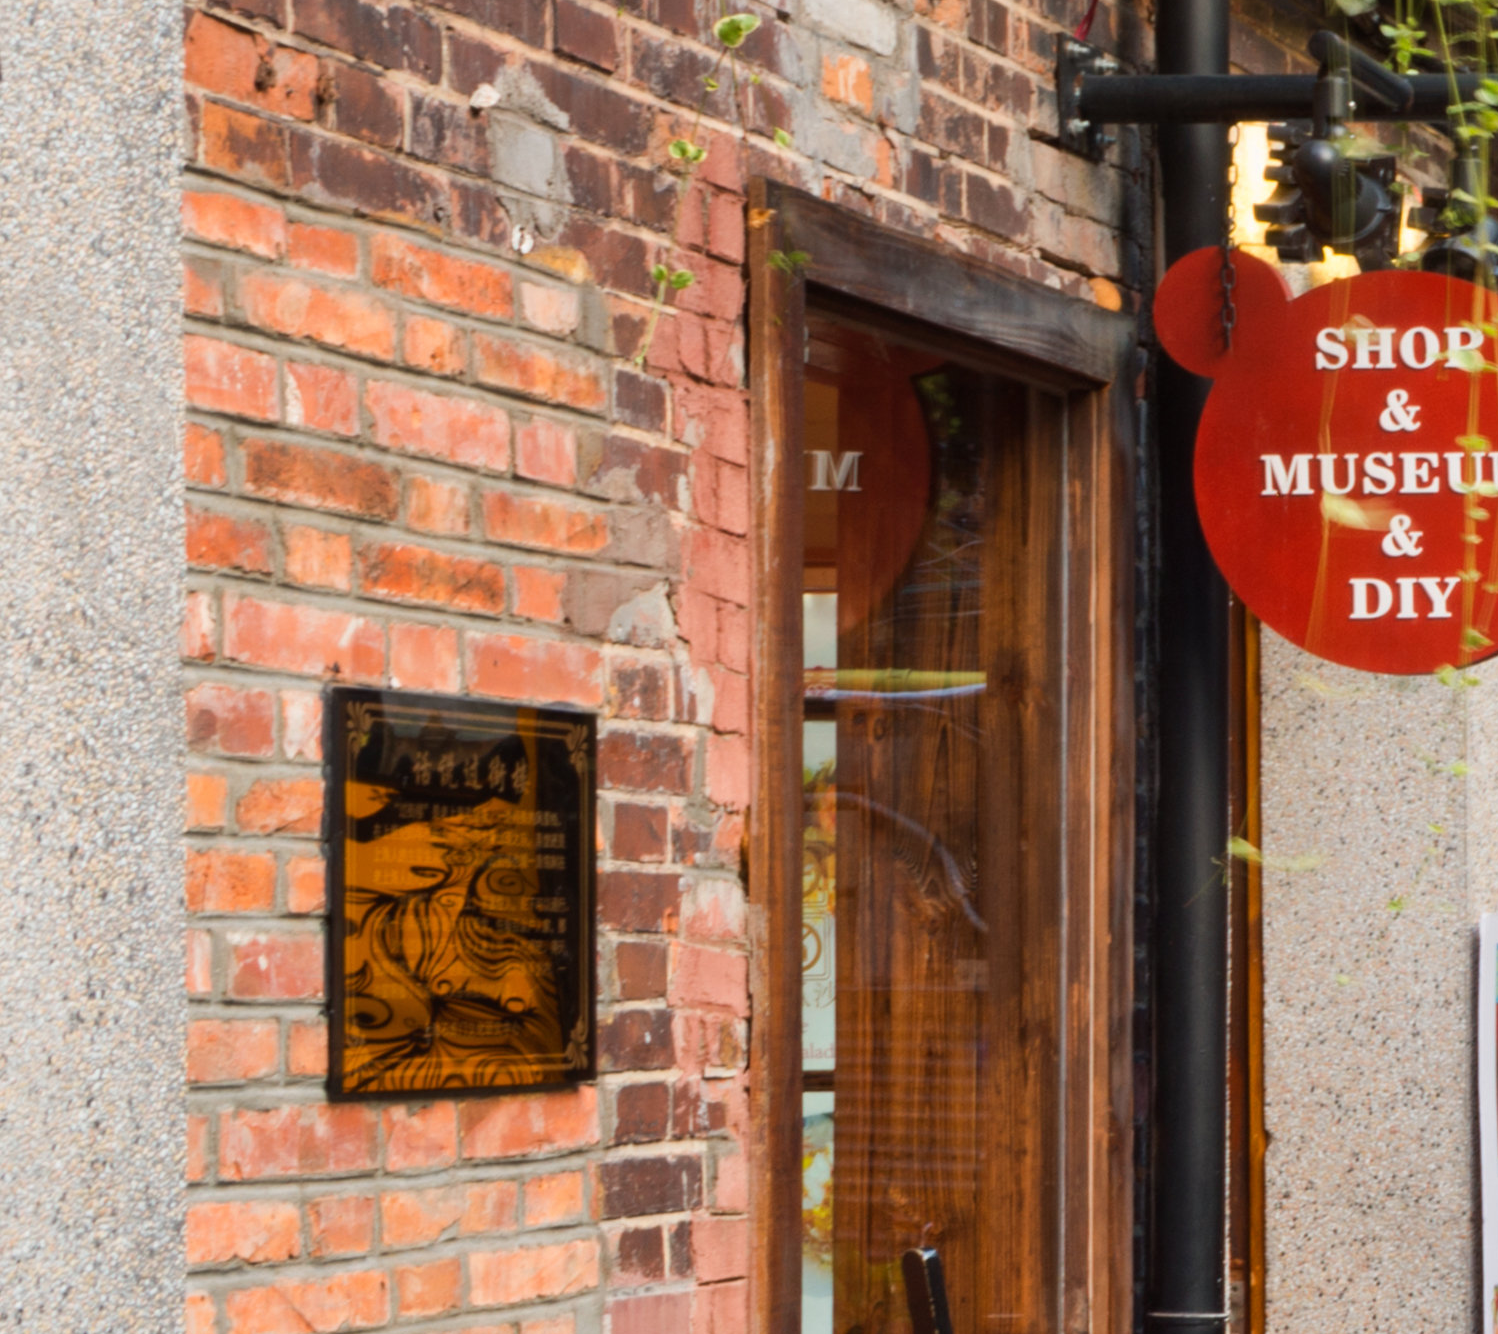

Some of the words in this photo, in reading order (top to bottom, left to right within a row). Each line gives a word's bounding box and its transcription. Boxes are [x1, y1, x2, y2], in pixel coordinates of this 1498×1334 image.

[1314, 326, 1486, 371] SHOP
[1378, 388, 1422, 433] &
[1380, 514, 1424, 558] &
[1348, 576, 1461, 620] DIY
